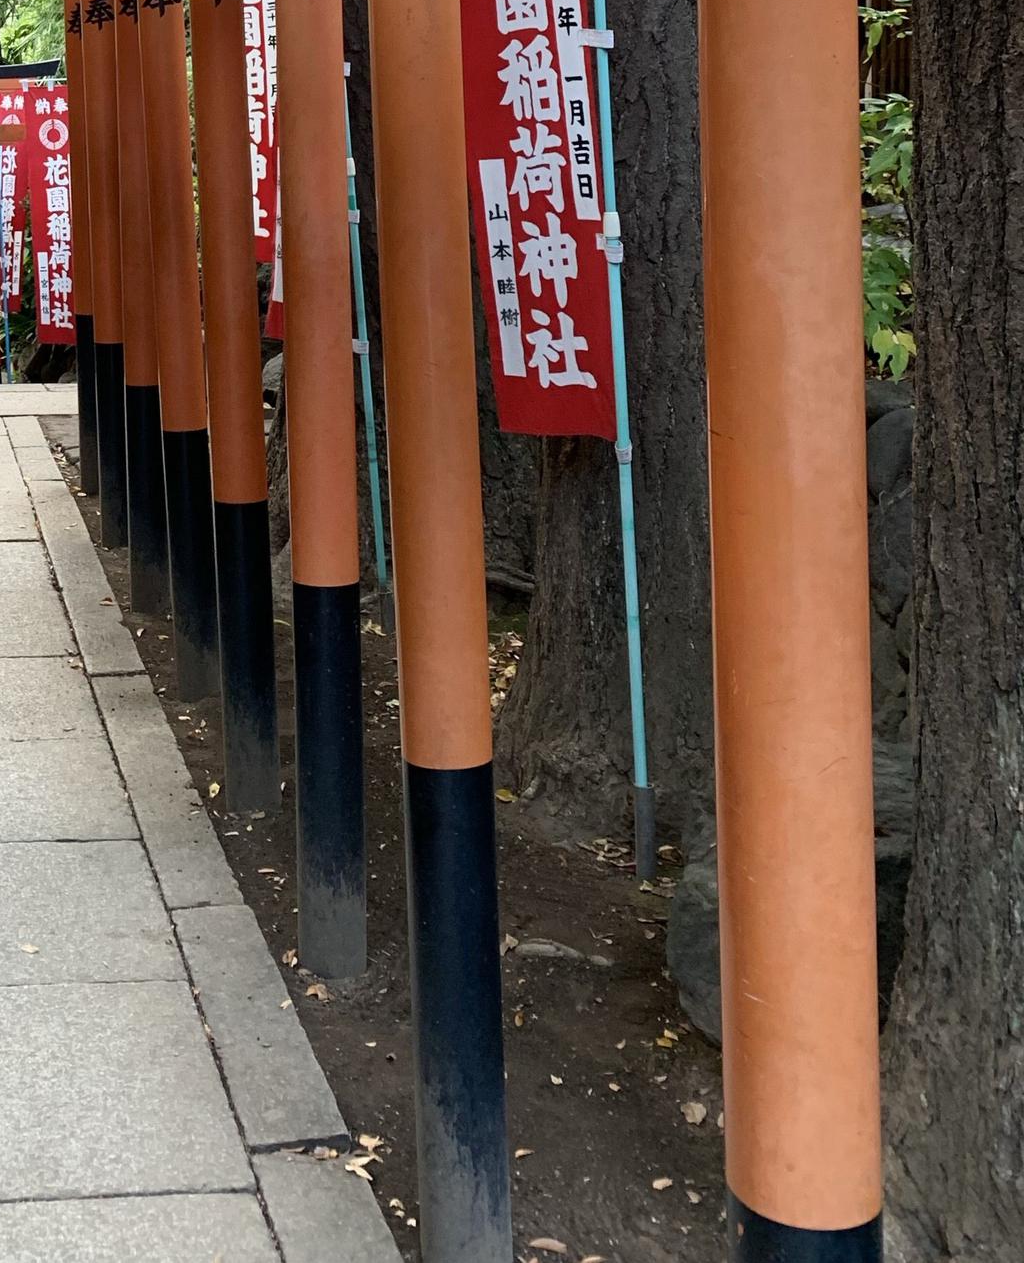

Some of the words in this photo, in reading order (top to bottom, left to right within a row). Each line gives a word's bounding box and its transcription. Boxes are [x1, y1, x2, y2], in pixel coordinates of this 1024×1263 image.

[43, 154, 74, 329] 花園稲荷神社
[488, 203, 519, 327] 山本睦樹
